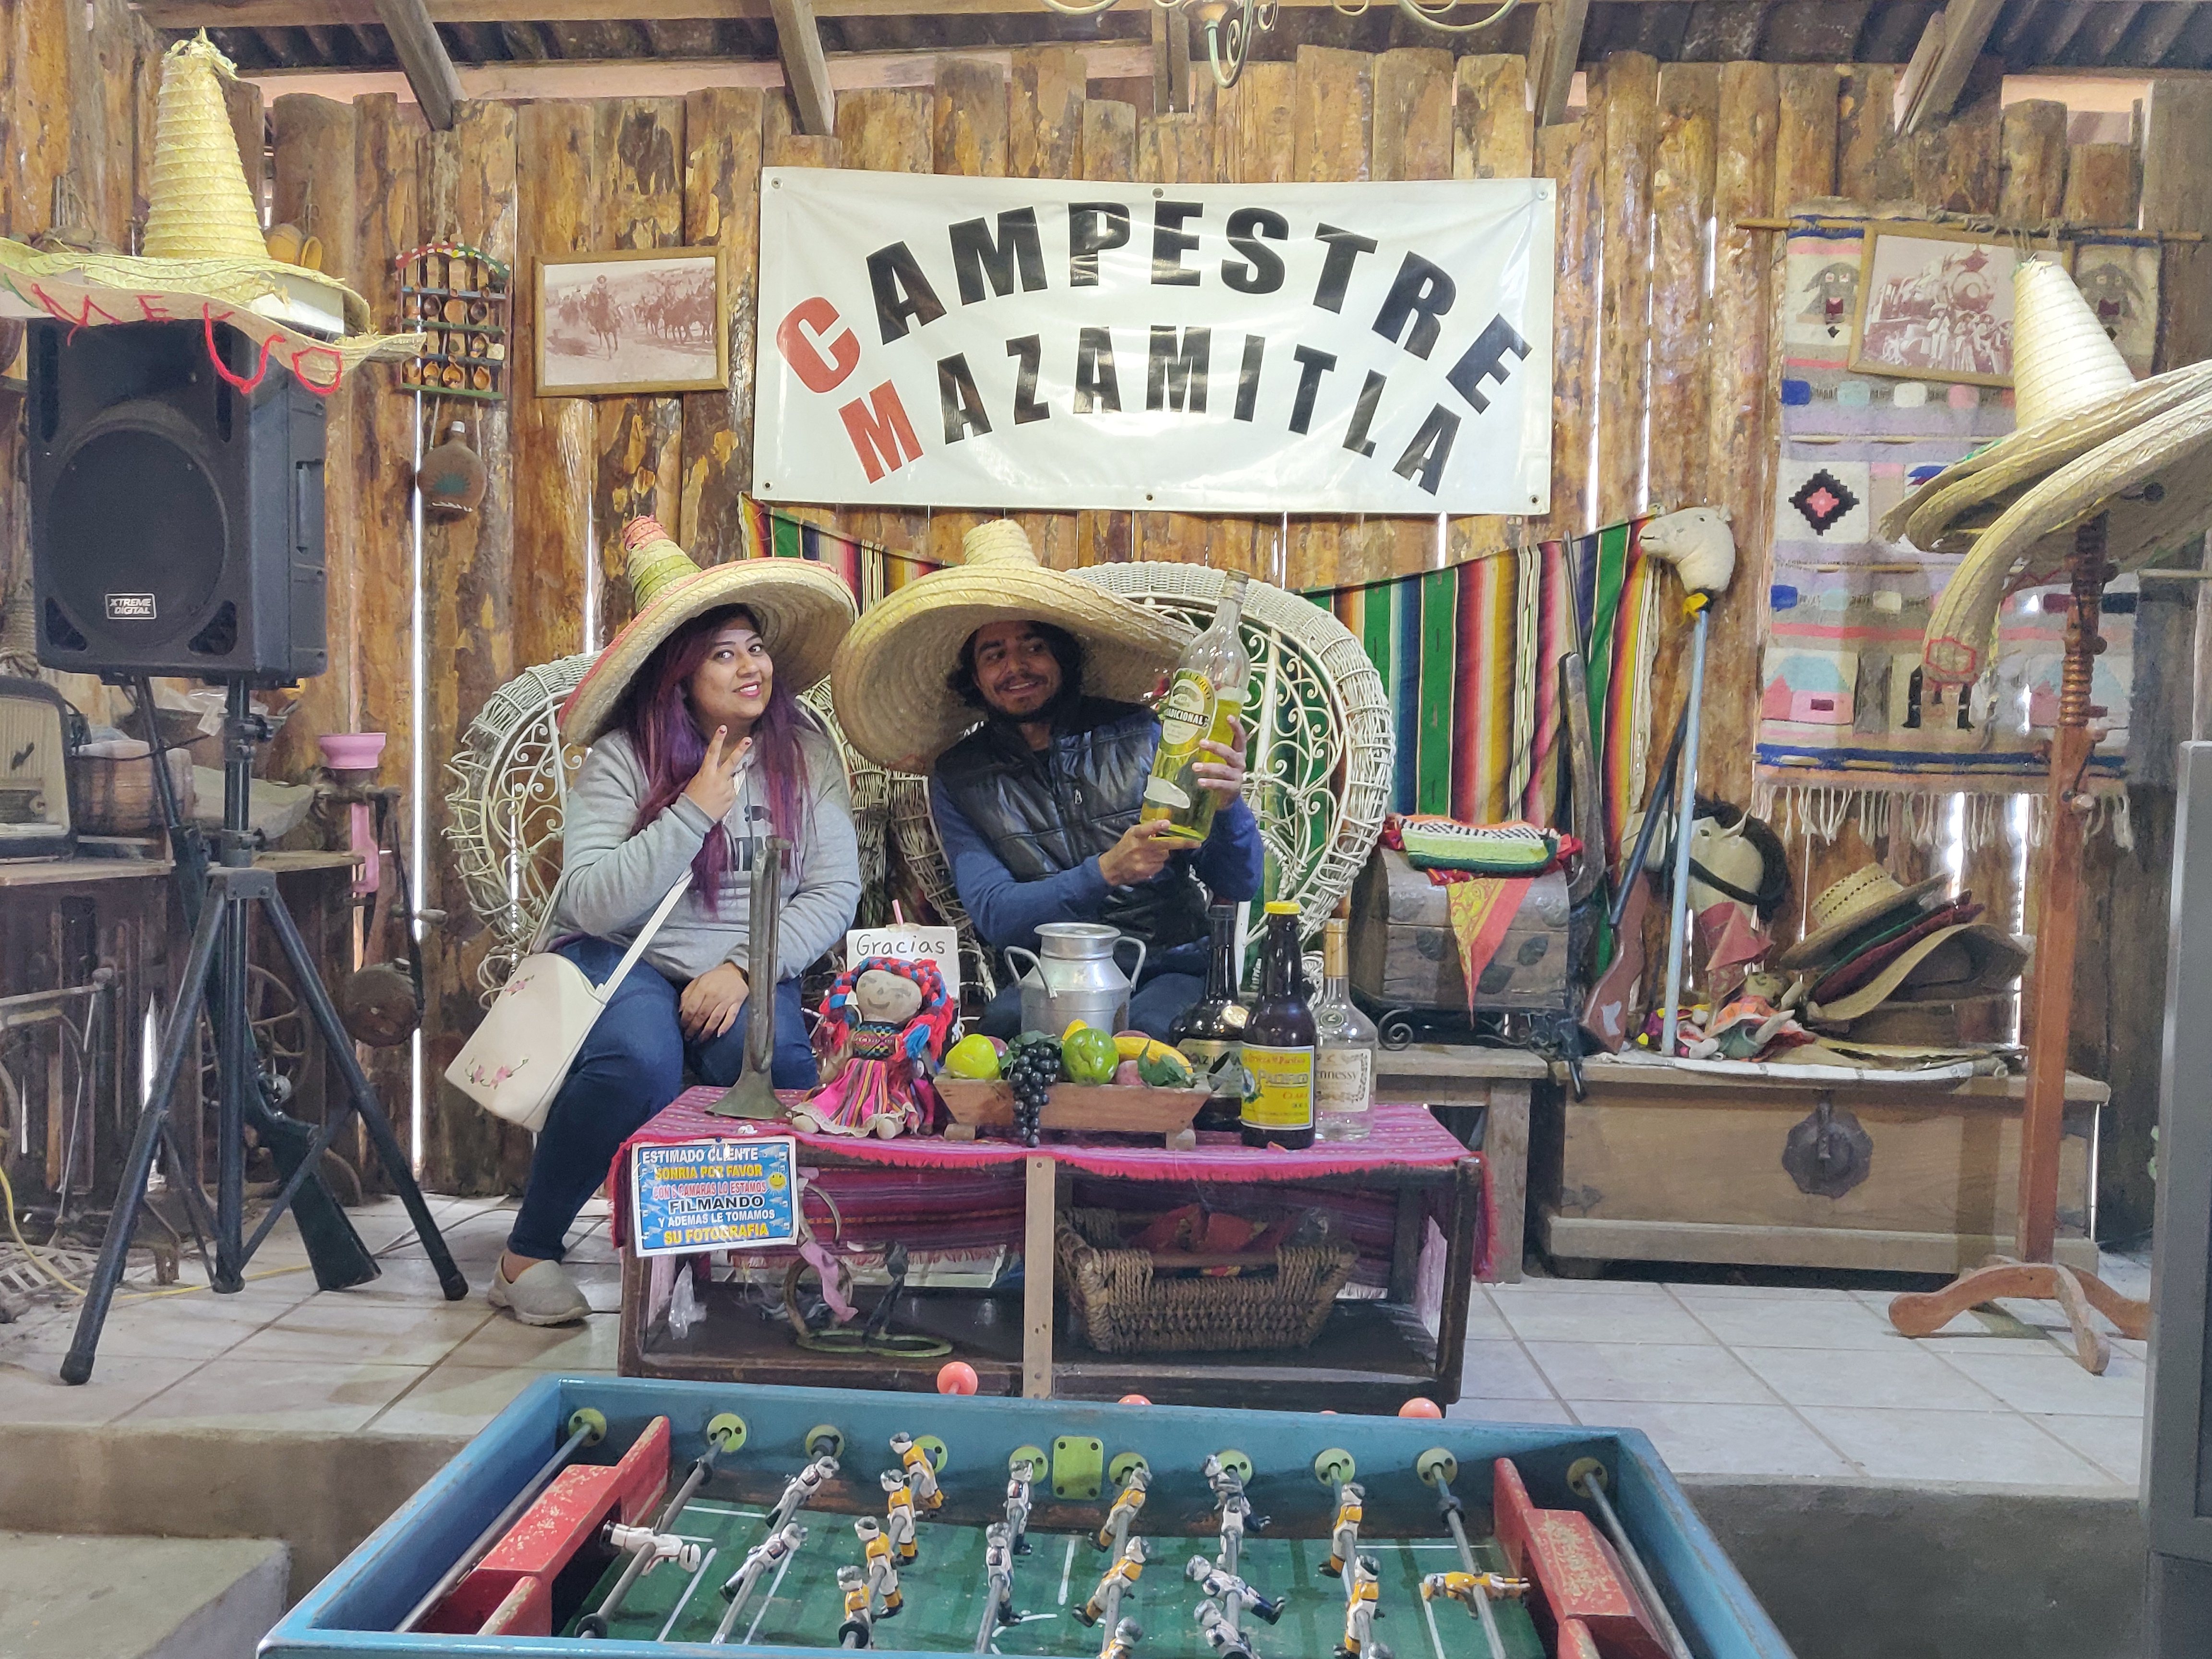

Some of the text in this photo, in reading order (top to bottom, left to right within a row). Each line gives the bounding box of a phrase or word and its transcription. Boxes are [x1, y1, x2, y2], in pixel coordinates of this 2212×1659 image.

[776, 201, 1532, 414] CAMPESTRE
[839, 325, 1461, 495] MAZAMITLA
[109, 598, 151, 607] XTREME
[1166, 708, 1203, 725] ADICIONAL
[856, 934, 946, 955] Gracias
[642, 1147, 758, 1164] ESTIMADO CLIENTE
[654, 1164, 762, 1180] SONRIA POR FAVOR
[653, 1185, 670, 1200] CON
[678, 1181, 716, 1198] CAMARAS
[719, 1181, 728, 1195] LO
[730, 1179, 767, 1194] ESTAMOS
[669, 1196, 764, 1214] FILMANDO
[658, 1209, 775, 1228] Y ADEMAS LE TOMAMOS
[664, 1223, 769, 1245] SU FOTOGRAFIA
